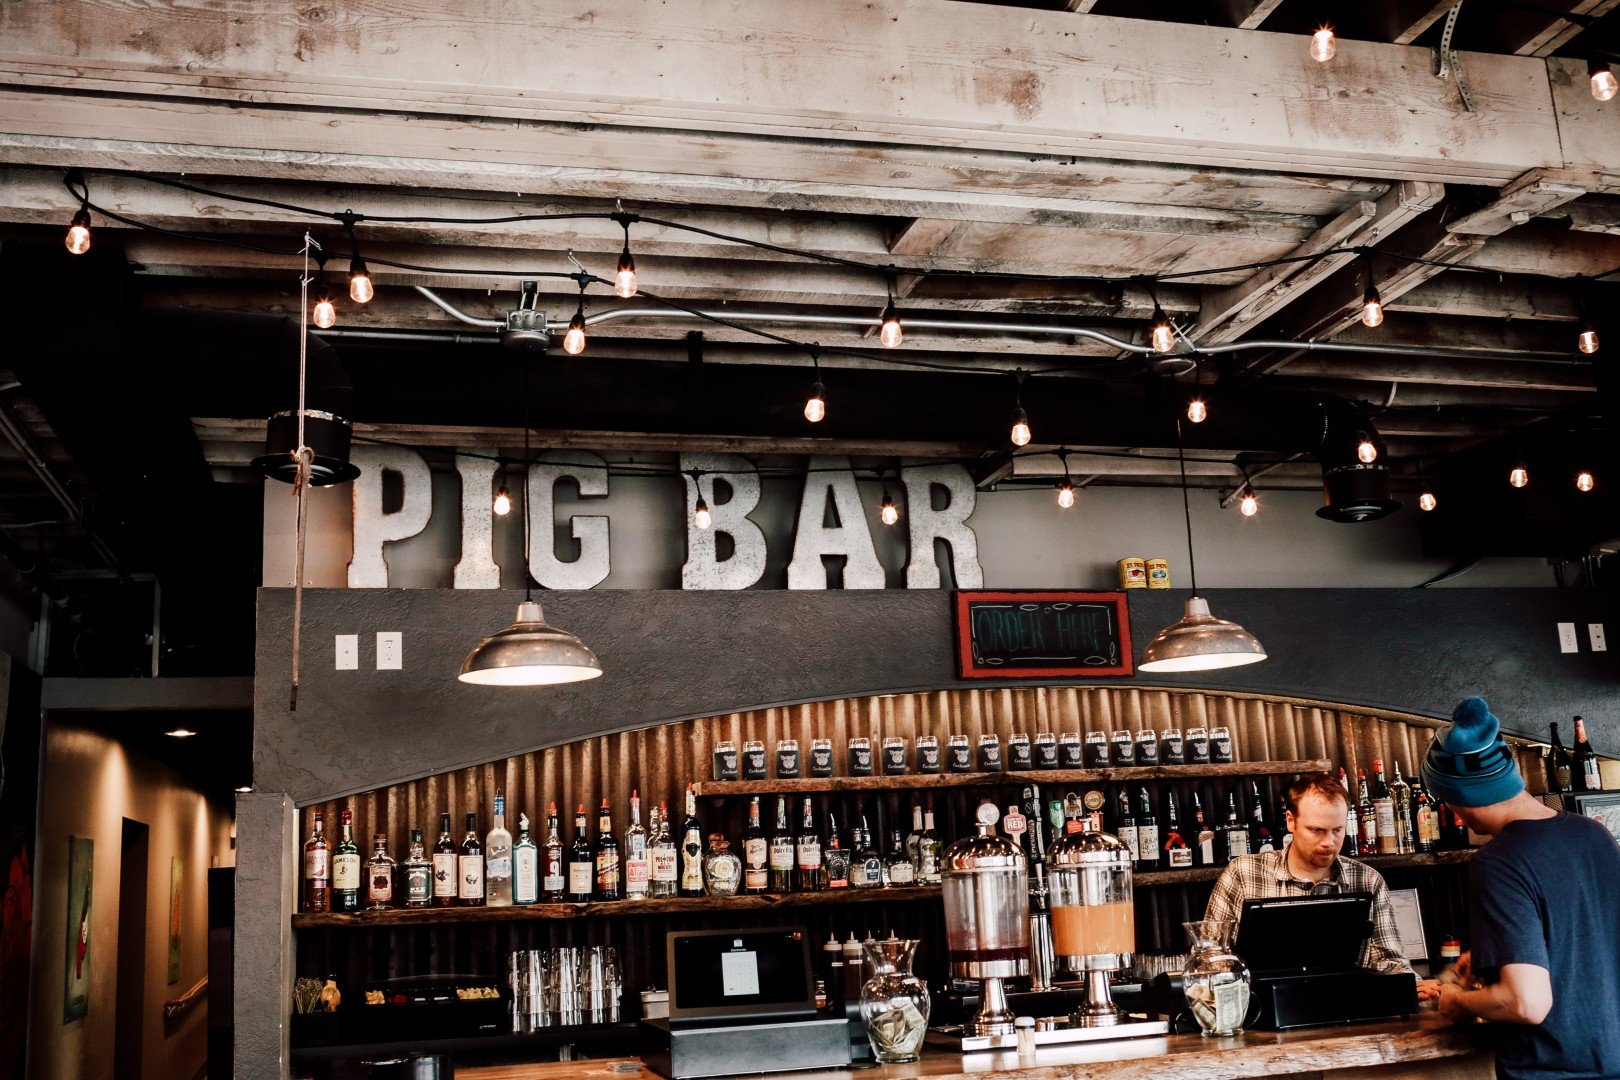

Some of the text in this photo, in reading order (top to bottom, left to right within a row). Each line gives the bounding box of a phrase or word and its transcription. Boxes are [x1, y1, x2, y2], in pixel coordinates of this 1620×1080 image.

[347, 447, 985, 590] PIG BAR
[977, 608, 1102, 653] ORDER HERE
[333, 857, 357, 865] JAMESON
